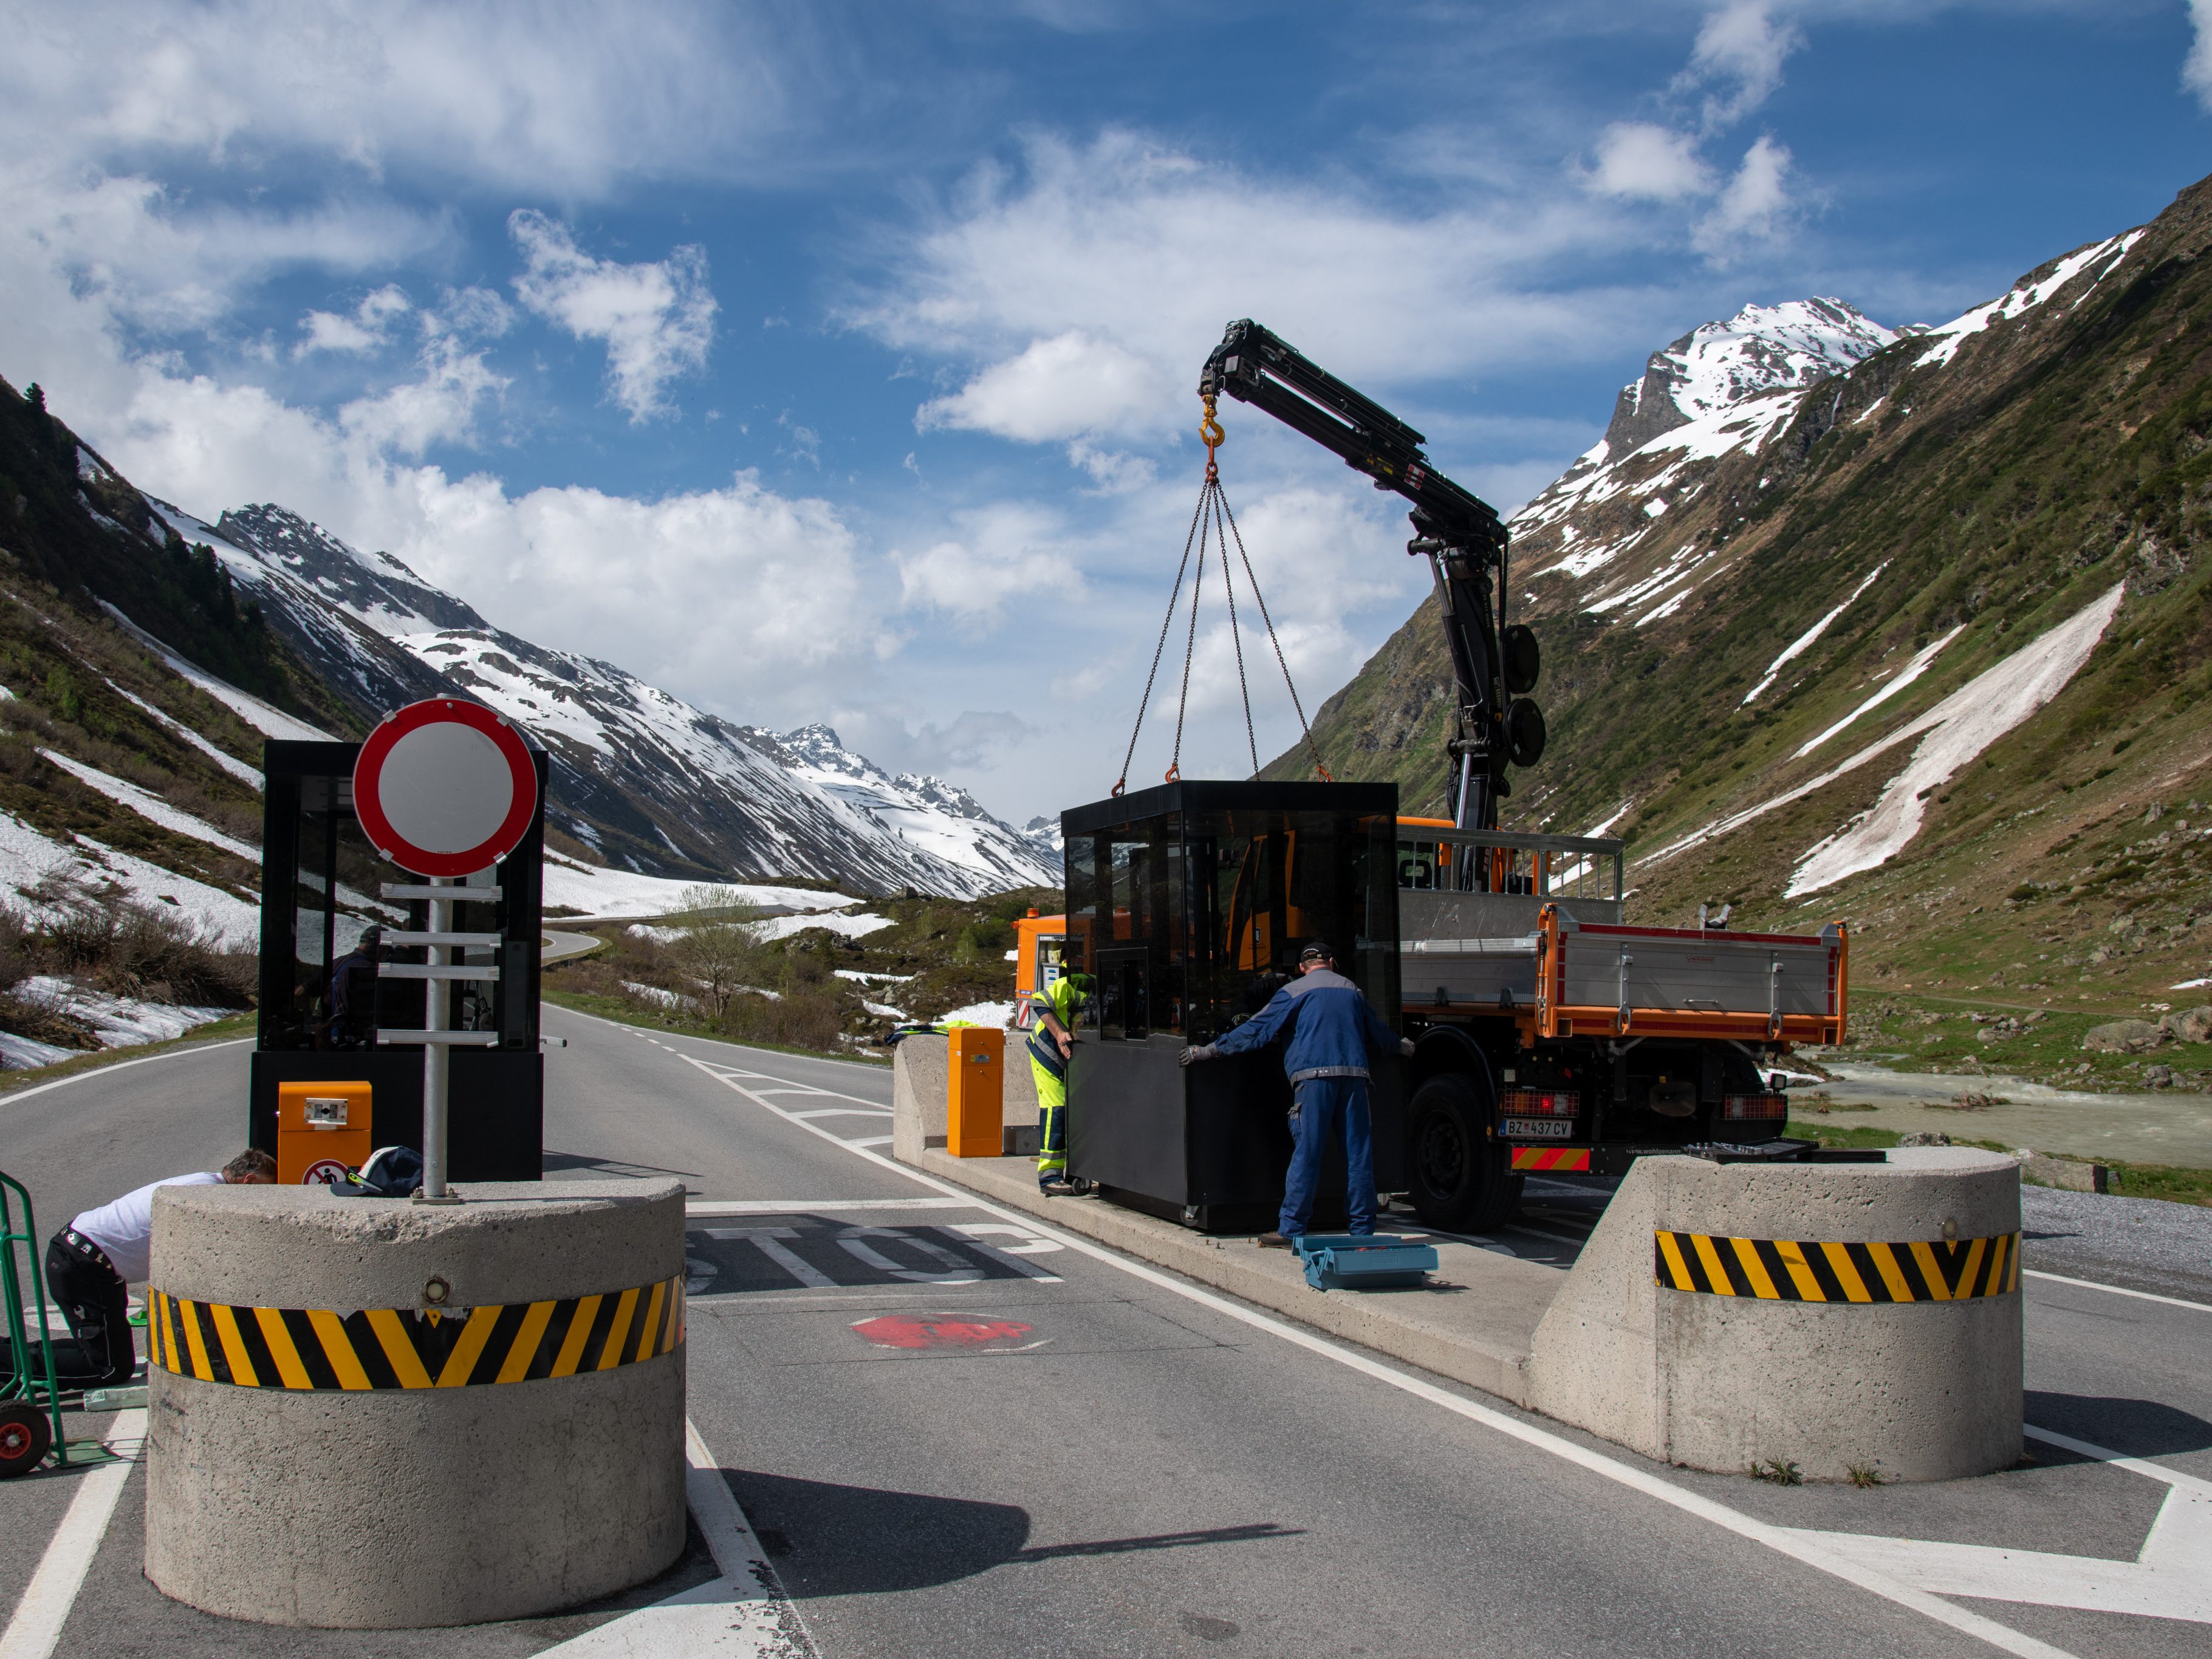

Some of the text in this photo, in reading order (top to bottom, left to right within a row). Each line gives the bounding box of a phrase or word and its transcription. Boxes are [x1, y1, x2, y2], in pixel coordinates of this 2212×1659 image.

[1508, 1121, 1522, 1134] BZ
[1530, 1122, 1551, 1135] 437
[1553, 1123, 1567, 1135] CV
